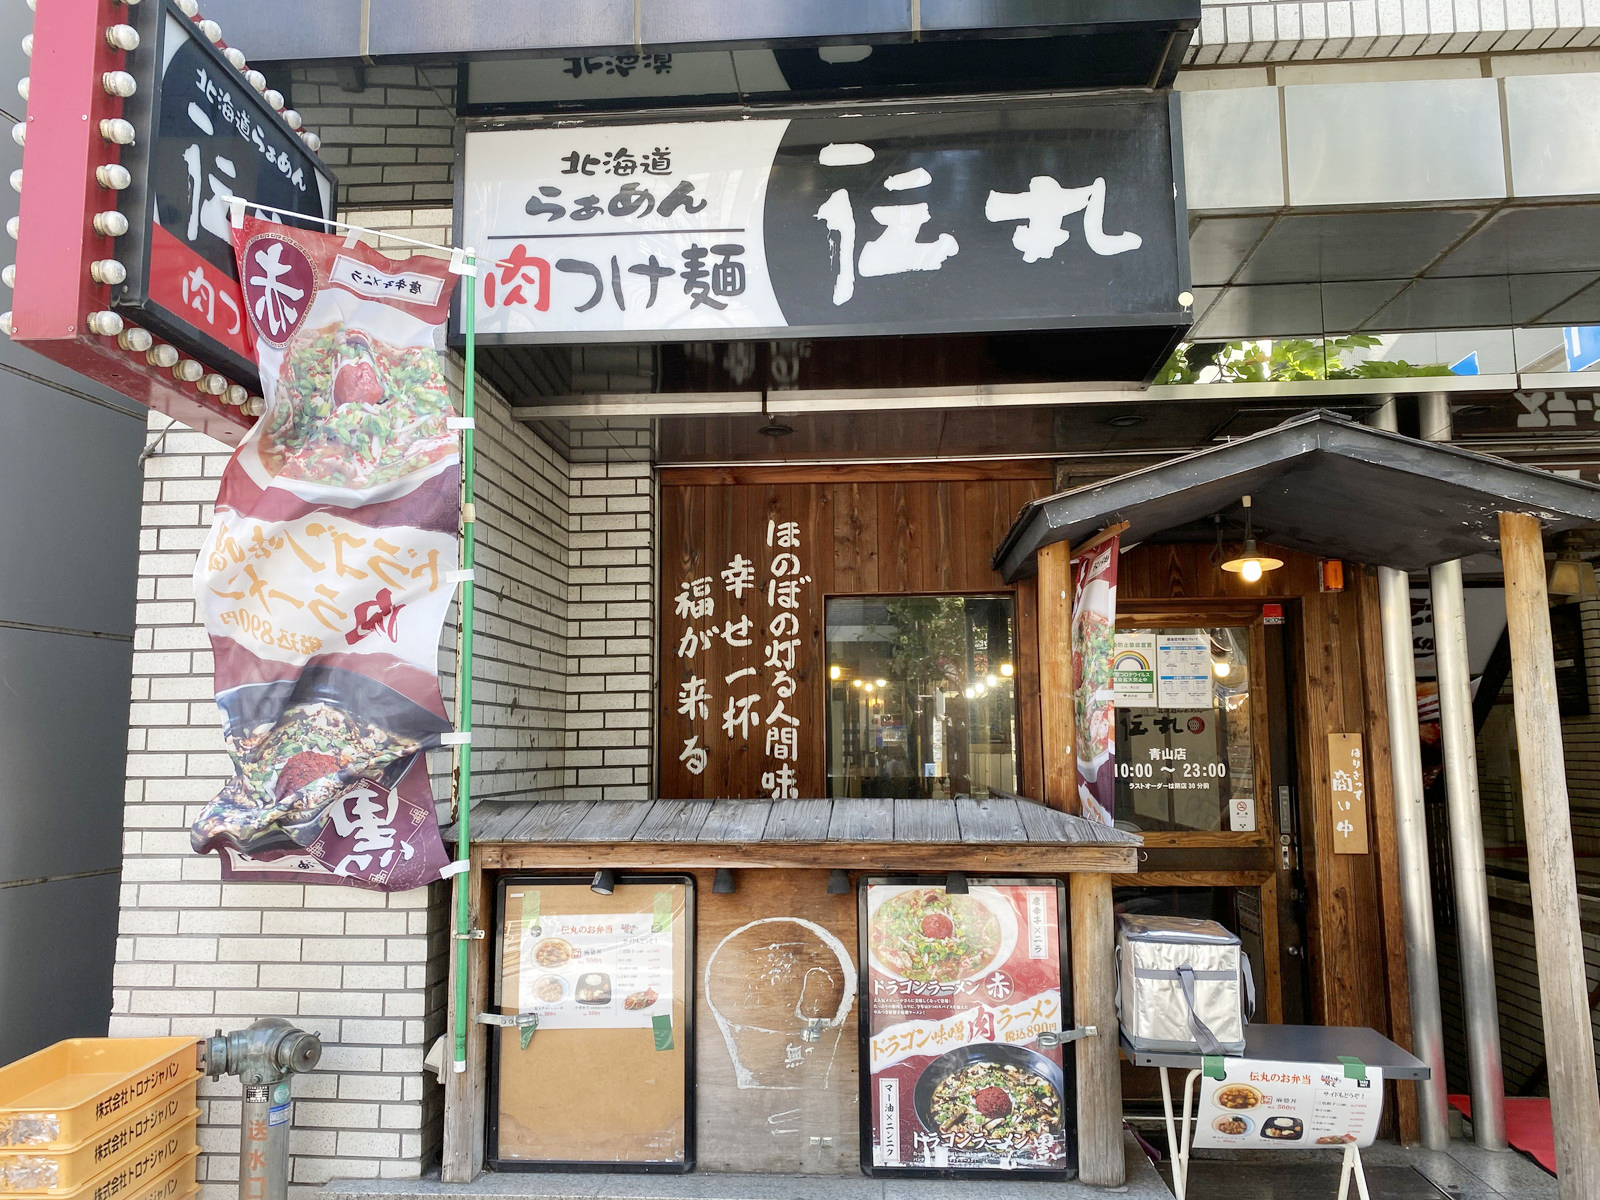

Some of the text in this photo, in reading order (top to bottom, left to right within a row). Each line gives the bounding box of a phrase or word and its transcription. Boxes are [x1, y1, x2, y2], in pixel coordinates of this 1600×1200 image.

[196, 67, 307, 192] 北海道らぁめん
[561, 147, 673, 176] 北海道
[525, 180, 708, 222] らぁめん
[813, 142, 1143, 306] 伝丸
[484, 243, 746, 313] 肉つけ麺
[675, 576, 719, 775] 福が来る
[721, 553, 761, 740] 幸せ一杯
[762, 519, 812, 799] ほのぼの灯る人間味
[1114, 763, 1153, 778] 10:00
[1183, 763, 1226, 778] 23:00
[1149, 748, 1187, 760] 青山店
[560, 924, 613, 935] 伝丸のお弁当
[874, 971, 1011, 998] ドラゴンラーメン 赤
[1005, 1023, 1057, 1042] 税込890円
[95, 1062, 179, 1121] 株式会社トロナジャパン
[1249, 1071, 1312, 1085] 伝丸のお弁当
[94, 1100, 178, 1164] 株式会社トロナジャパン
[884, 1083, 894, 1157] マー油×ニンニク
[913, 1131, 1029, 1150] ドラゴンラーメン
[245, 1120, 268, 1198] 送水口
